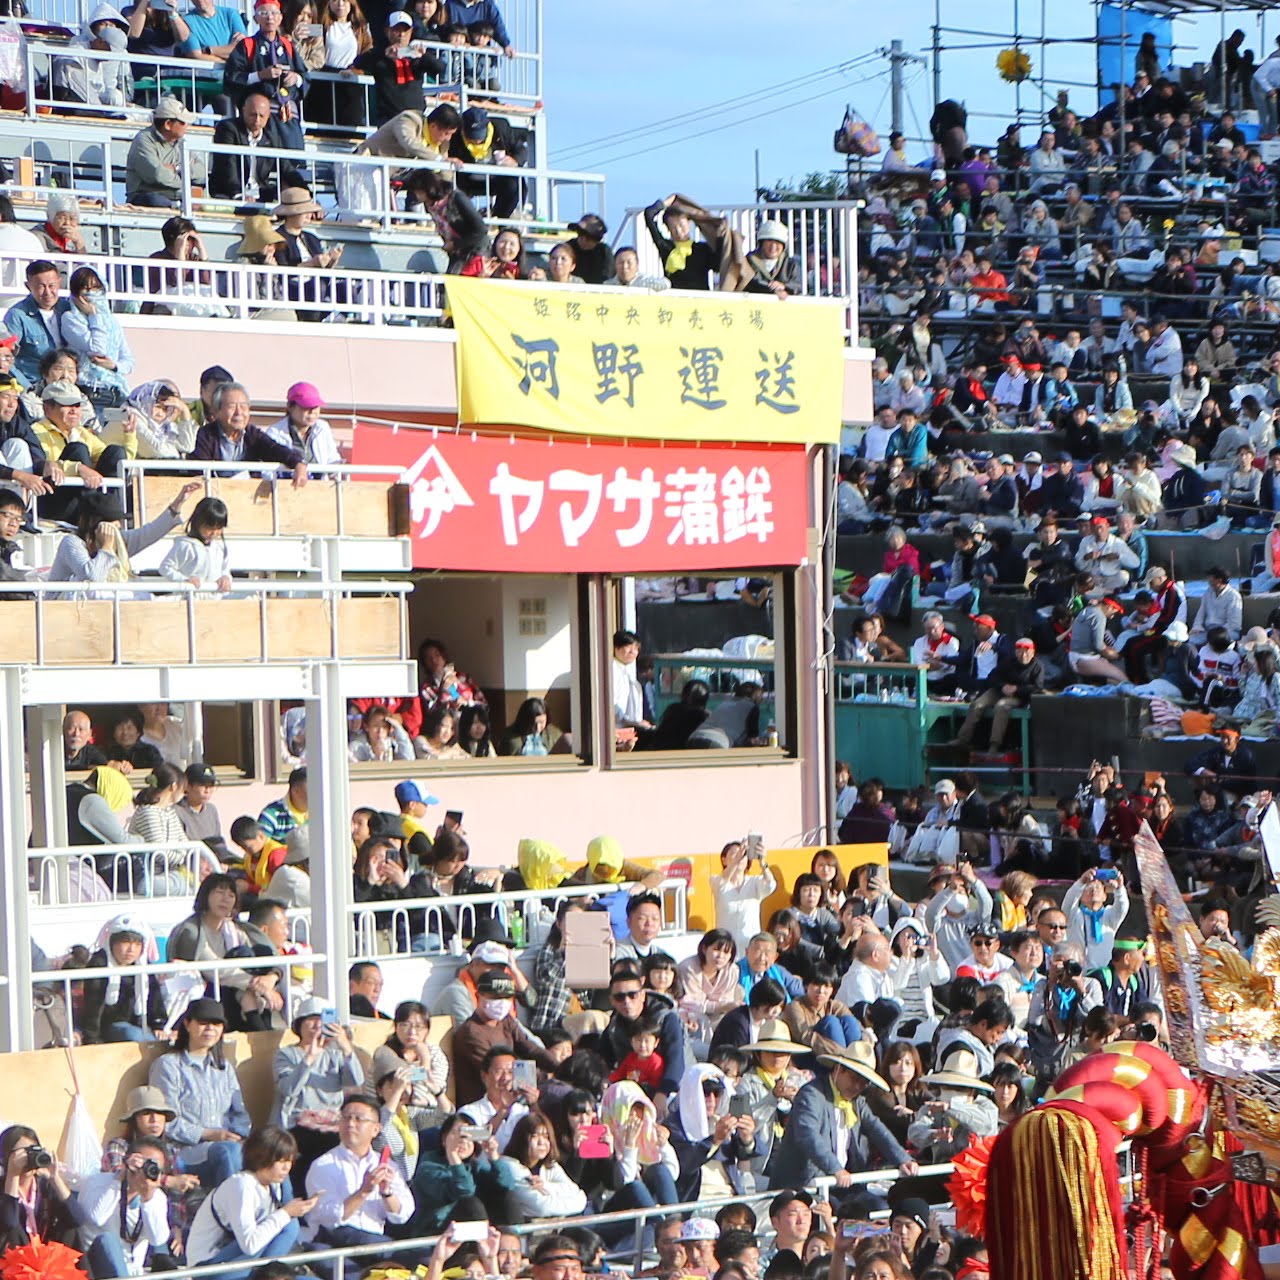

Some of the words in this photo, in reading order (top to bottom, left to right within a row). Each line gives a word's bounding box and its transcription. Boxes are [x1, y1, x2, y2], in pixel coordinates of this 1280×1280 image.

[533, 297, 765, 330] 姫路中央卸売市場
[511, 332, 801, 415] 河野運送
[489, 461, 775, 547] ヤマサ蒲鉾
